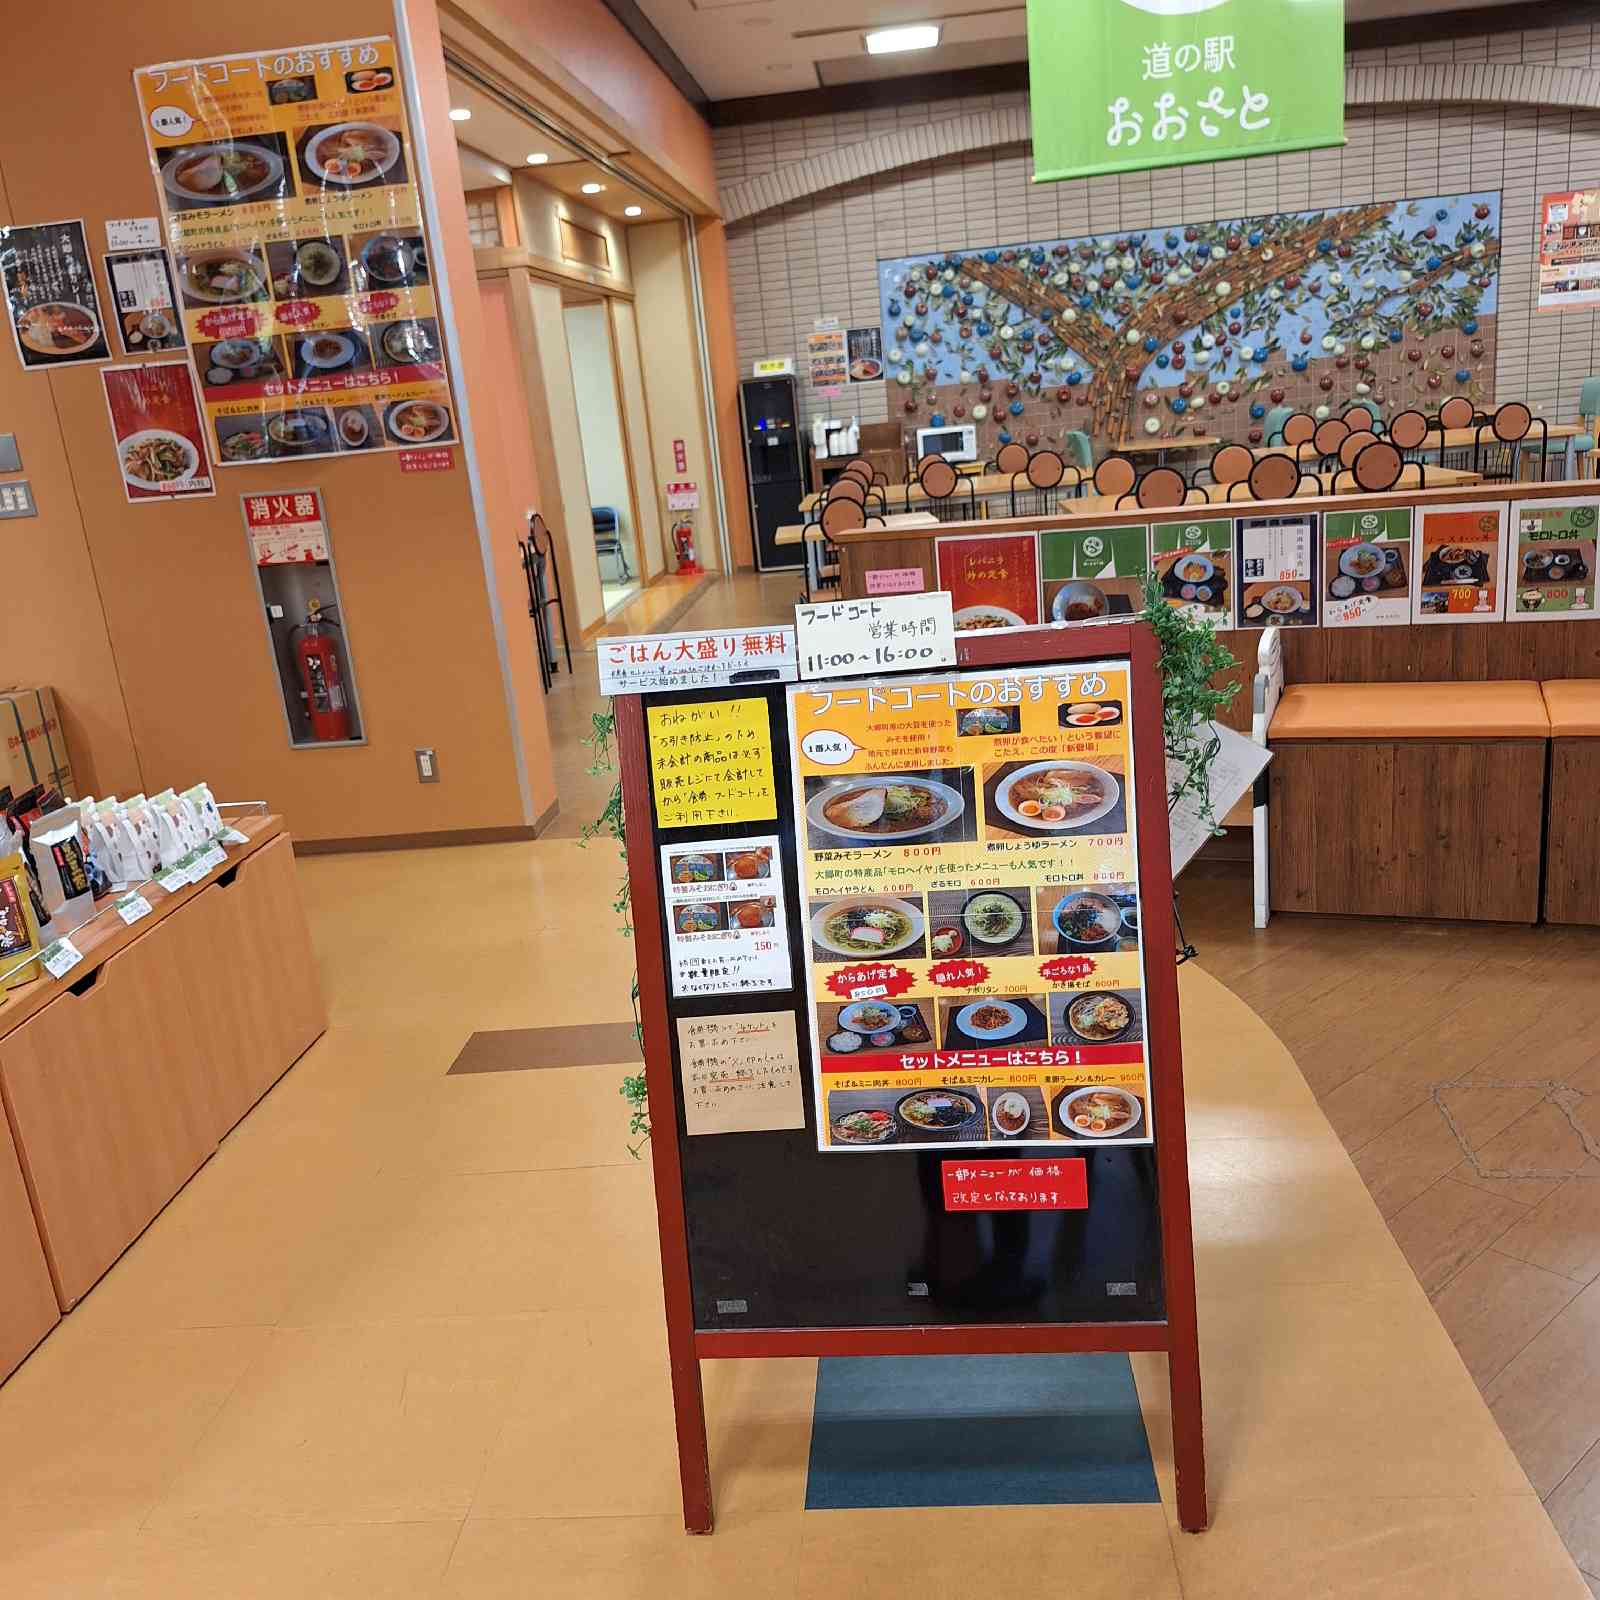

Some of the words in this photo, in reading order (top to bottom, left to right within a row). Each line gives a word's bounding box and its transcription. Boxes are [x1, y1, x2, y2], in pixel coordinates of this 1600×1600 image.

[150, 46, 379, 92] フードコートのおすすめ
[1142, 35, 1235, 80] 道の駅
[1106, 85, 1271, 146] おおさと
[264, 371, 400, 396] セットメニューはこちら！
[250, 494, 314, 520] 消火器
[1452, 589, 1471, 600] 700
[868, 615, 937, 641] 営業時間
[609, 633, 787, 664] ごはん大盛り無料
[811, 672, 1108, 716] フードコートのおすすめ
[814, 849, 893, 862] 野菜みそラーメン
[903, 846, 941, 857] 800円
[987, 839, 1078, 851] 煮卵しょうゆラーメン
[1088, 838, 1124, 847] 700円
[815, 886, 875, 896] モロヘイヤうどん
[837, 968, 899, 984] からあげ定食
[899, 1050, 1082, 1070] セットメニューはこちら！
